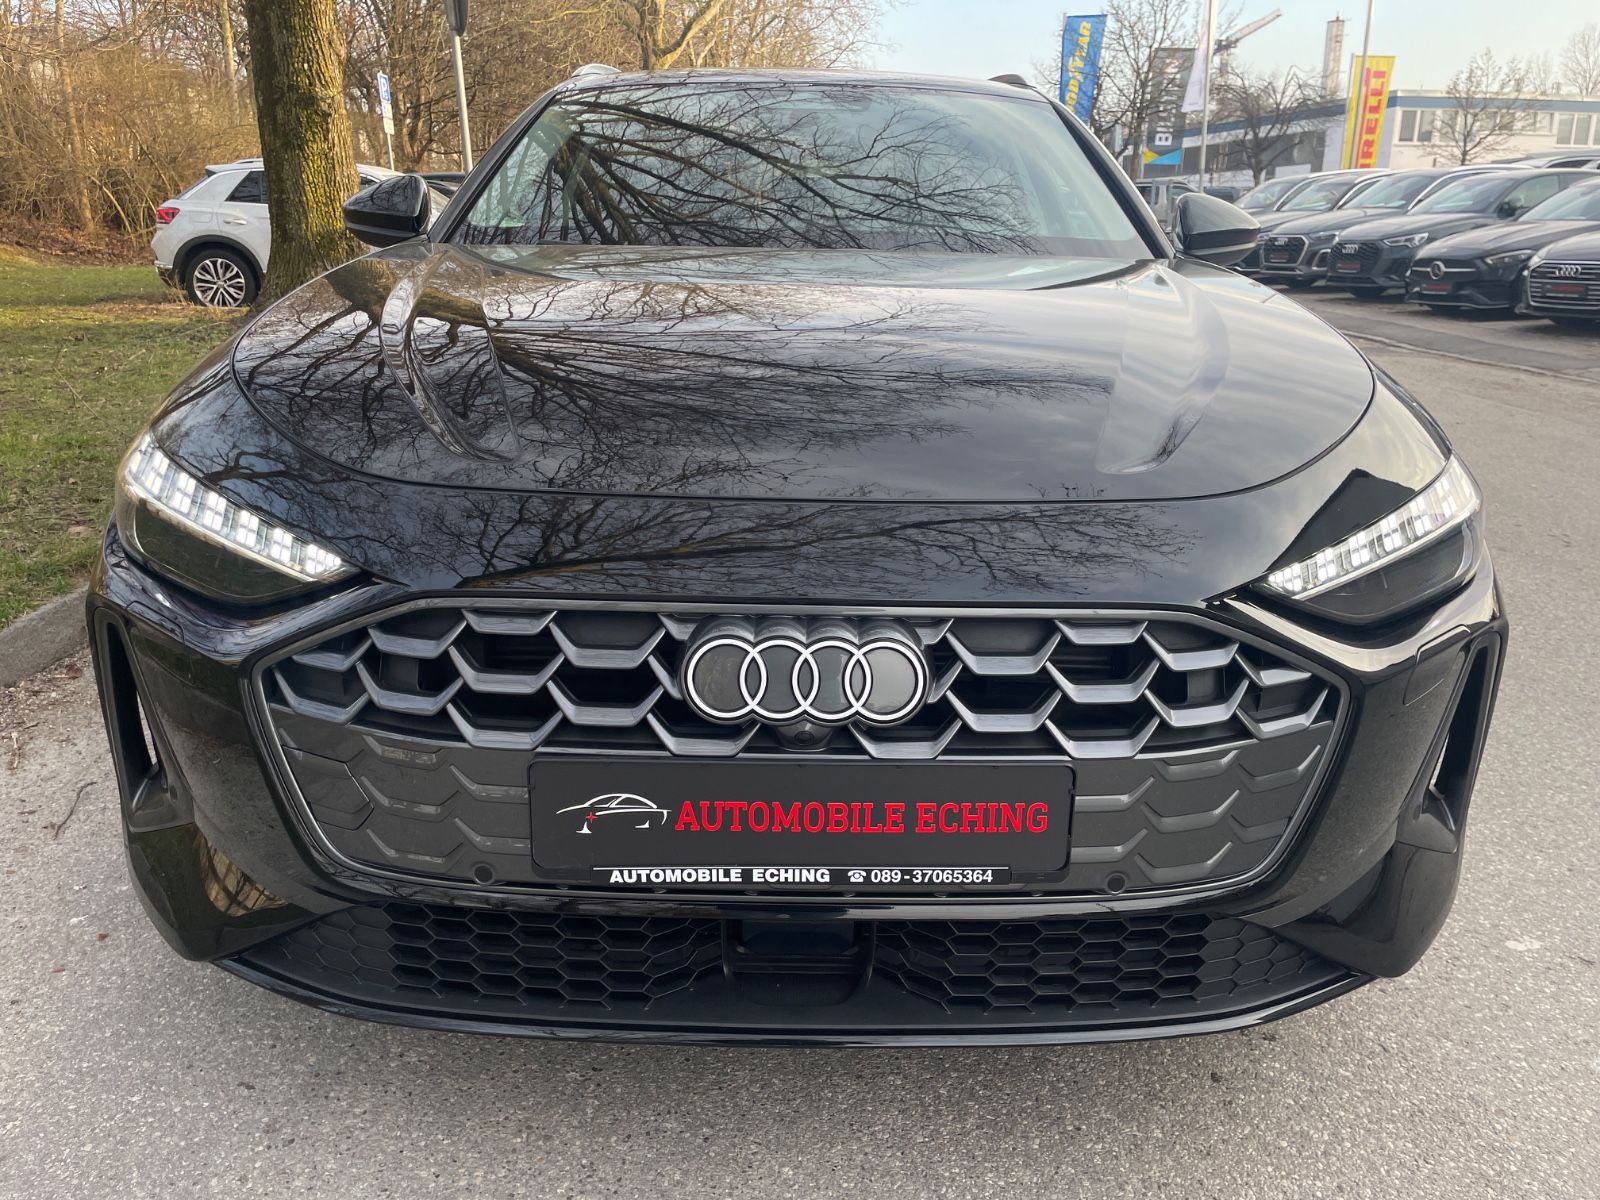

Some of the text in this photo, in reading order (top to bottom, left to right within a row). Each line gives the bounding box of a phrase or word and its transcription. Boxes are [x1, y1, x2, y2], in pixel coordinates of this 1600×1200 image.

[1065, 21, 1091, 113] ODYEAR
[1355, 67, 1386, 169] IRELLI
[675, 801, 1048, 833] AUTOMOBILE ECHING
[609, 868, 993, 883] AUTOMOBILE ECHING 089-37065364
